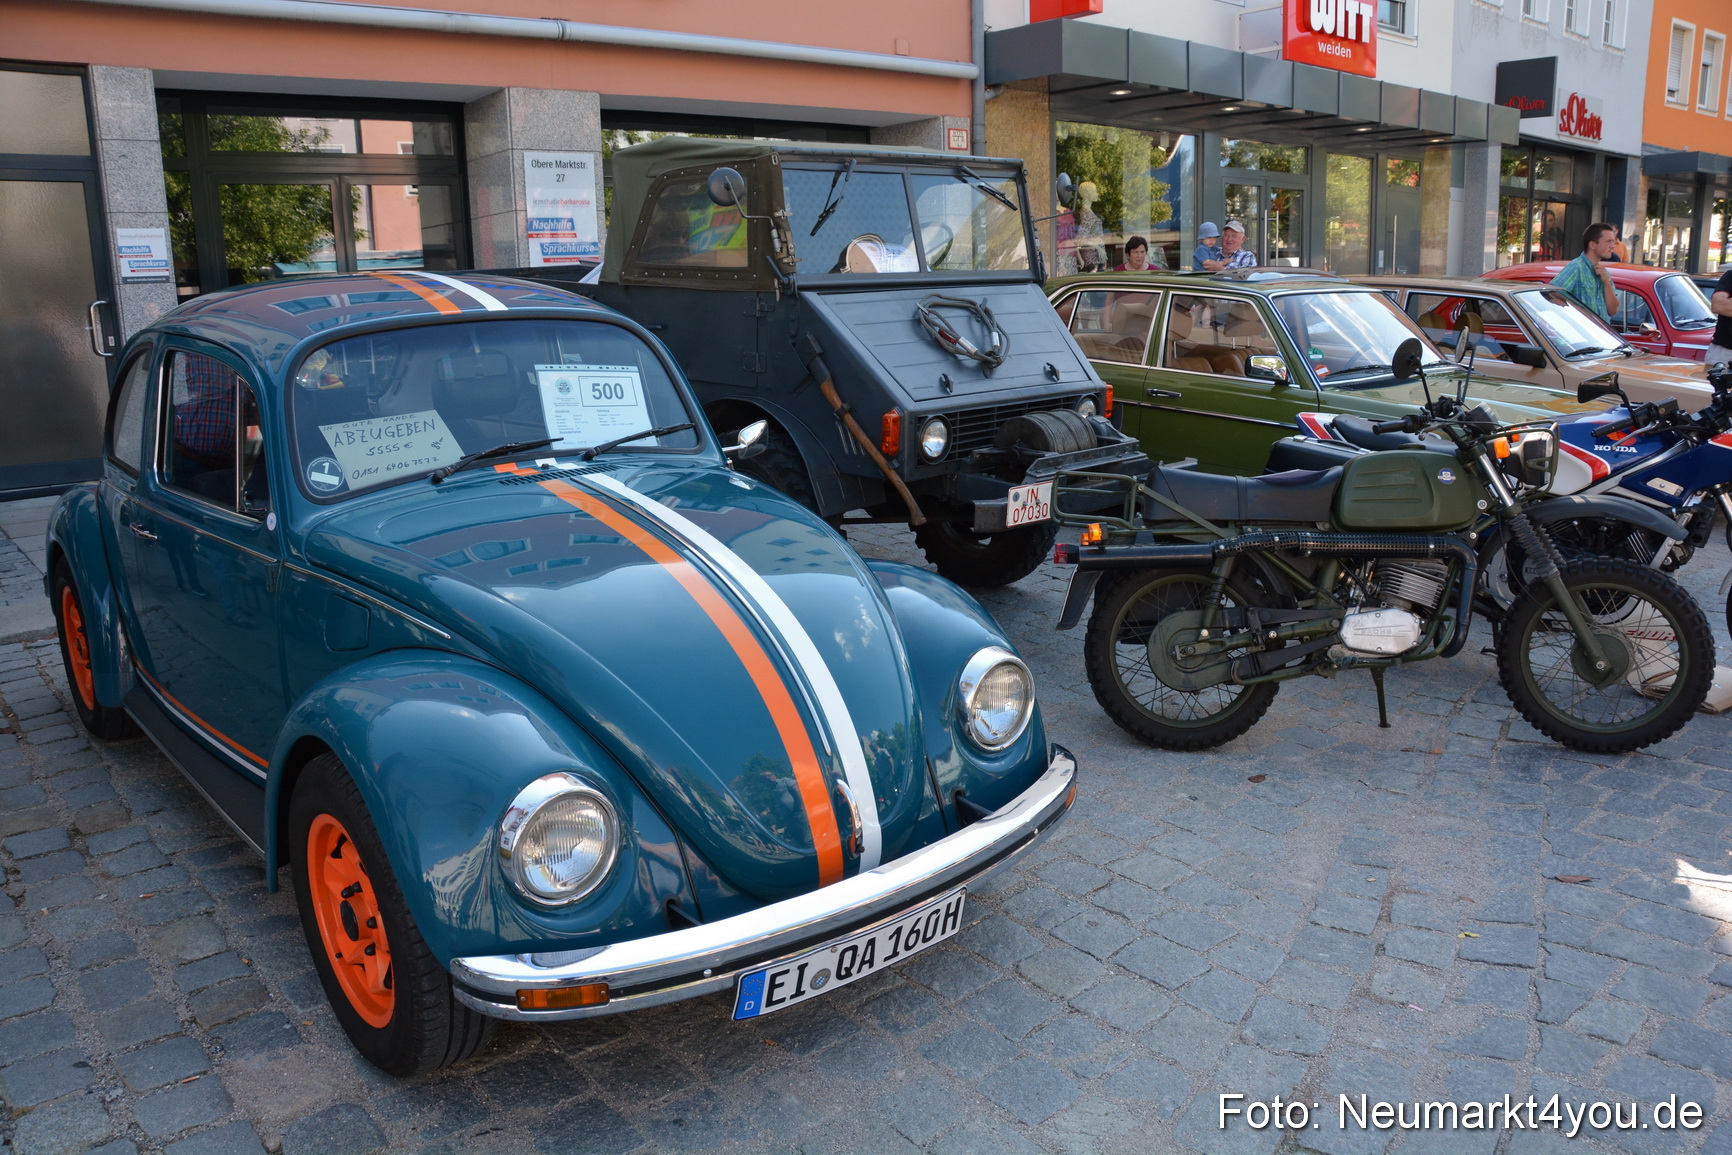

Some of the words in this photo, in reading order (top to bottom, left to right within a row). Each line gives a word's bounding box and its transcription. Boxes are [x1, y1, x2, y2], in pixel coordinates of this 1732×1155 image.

[1310, 0, 1373, 43] WITT
[1318, 41, 1352, 58] weiden
[1503, 95, 1546, 110] Oliver
[531, 159, 553, 168] Obere
[555, 160, 588, 169] Marktstr.
[555, 174, 565, 182] 27
[532, 219, 572, 230] Nachhilfe
[543, 243, 595, 255] Sprachkurse
[130, 260, 166, 268] Sprachkurse
[592, 382, 624, 400] 500
[342, 420, 373, 429] GUTE
[333, 419, 436, 448] ABZUGEBEN
[366, 443, 400, 456] 5555
[322, 462, 330, 474] 1
[352, 466, 379, 480] 0151
[1026, 487, 1039, 503] IN
[1013, 502, 1049, 523] 07030
[765, 962, 809, 1009] EI
[835, 936, 877, 981] QA
[883, 896, 962, 962] 160H
[744, 1000, 755, 1011] D
